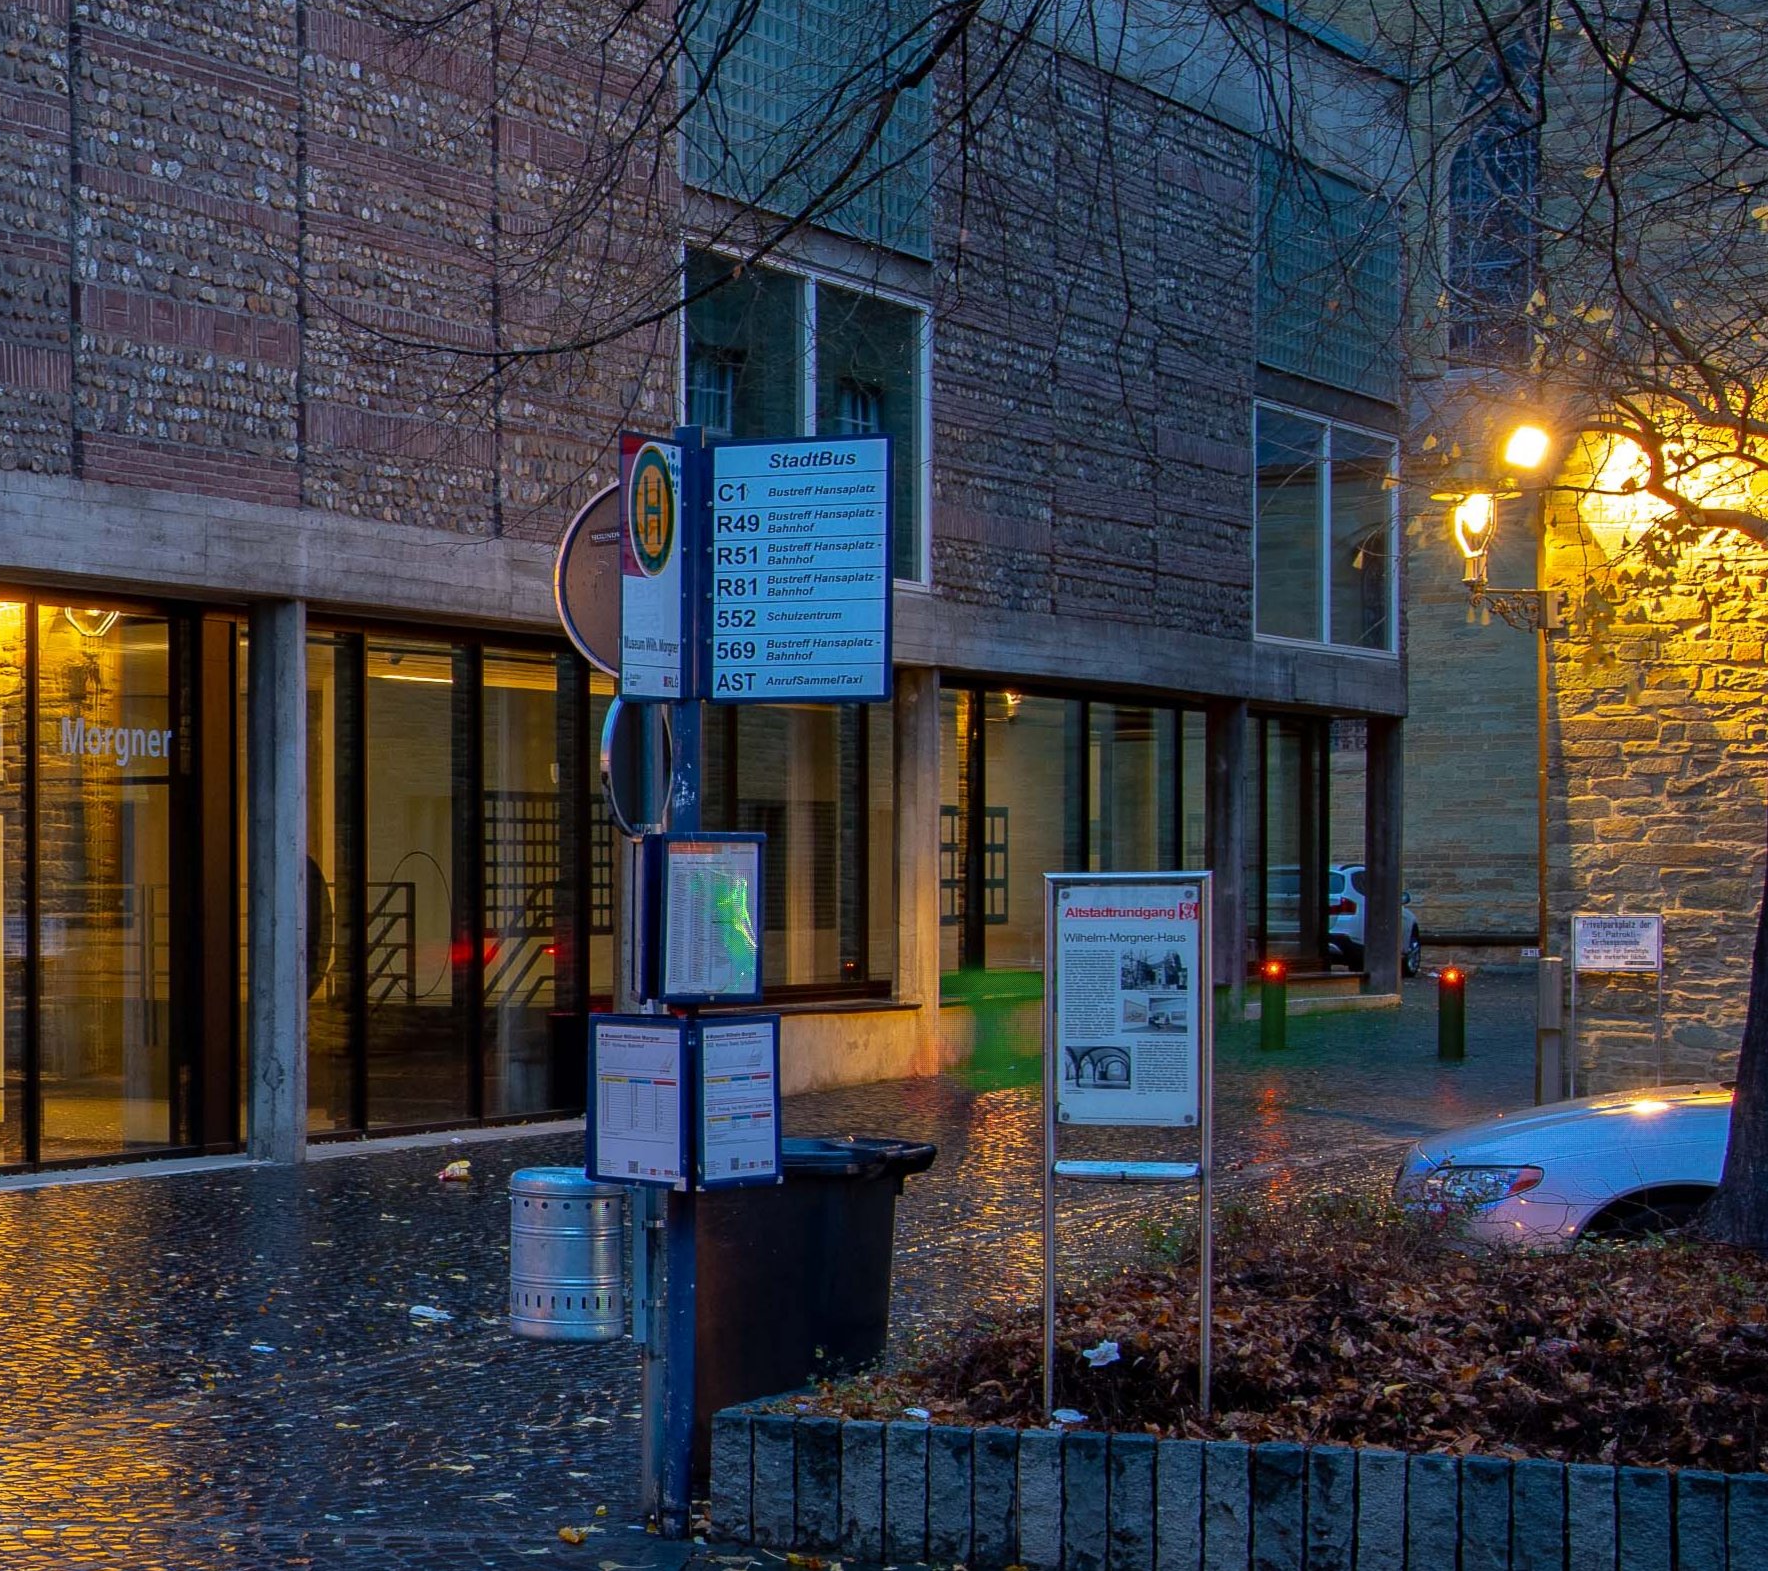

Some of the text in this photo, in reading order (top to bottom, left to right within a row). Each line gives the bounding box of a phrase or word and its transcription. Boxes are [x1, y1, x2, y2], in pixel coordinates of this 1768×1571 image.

[768, 451, 856, 469] StadtBus
[718, 483, 876, 502] C1 Bustreff Hansaplatz
[717, 514, 760, 533] R49
[768, 511, 812, 522] Bustreff
[814, 508, 876, 520] Hansaplatz
[767, 523, 814, 533] Bahnhof
[717, 546, 758, 565] R51
[767, 543, 812, 553] Bustreff
[814, 540, 876, 551] Hansaplatz
[767, 555, 814, 565] Bahnhof
[717, 578, 758, 596] R81
[767, 575, 812, 585] Bustreff
[814, 572, 875, 583] Hansaplatz
[767, 586, 814, 596] Bahnhof
[717, 609, 842, 628] 552 Schulzentrum
[717, 641, 756, 659] 569
[766, 638, 812, 649] Bustreff
[813, 636, 875, 647] Hansaplatz
[766, 651, 813, 661] Bahnhof
[717, 673, 863, 691] AST AnrufSammelTaxi
[62, 716, 172, 766] Morgner
[1065, 906, 1175, 919] Altstadtrundgang
[1064, 933, 1186, 944] Wilhelm-Morgner-Haus
